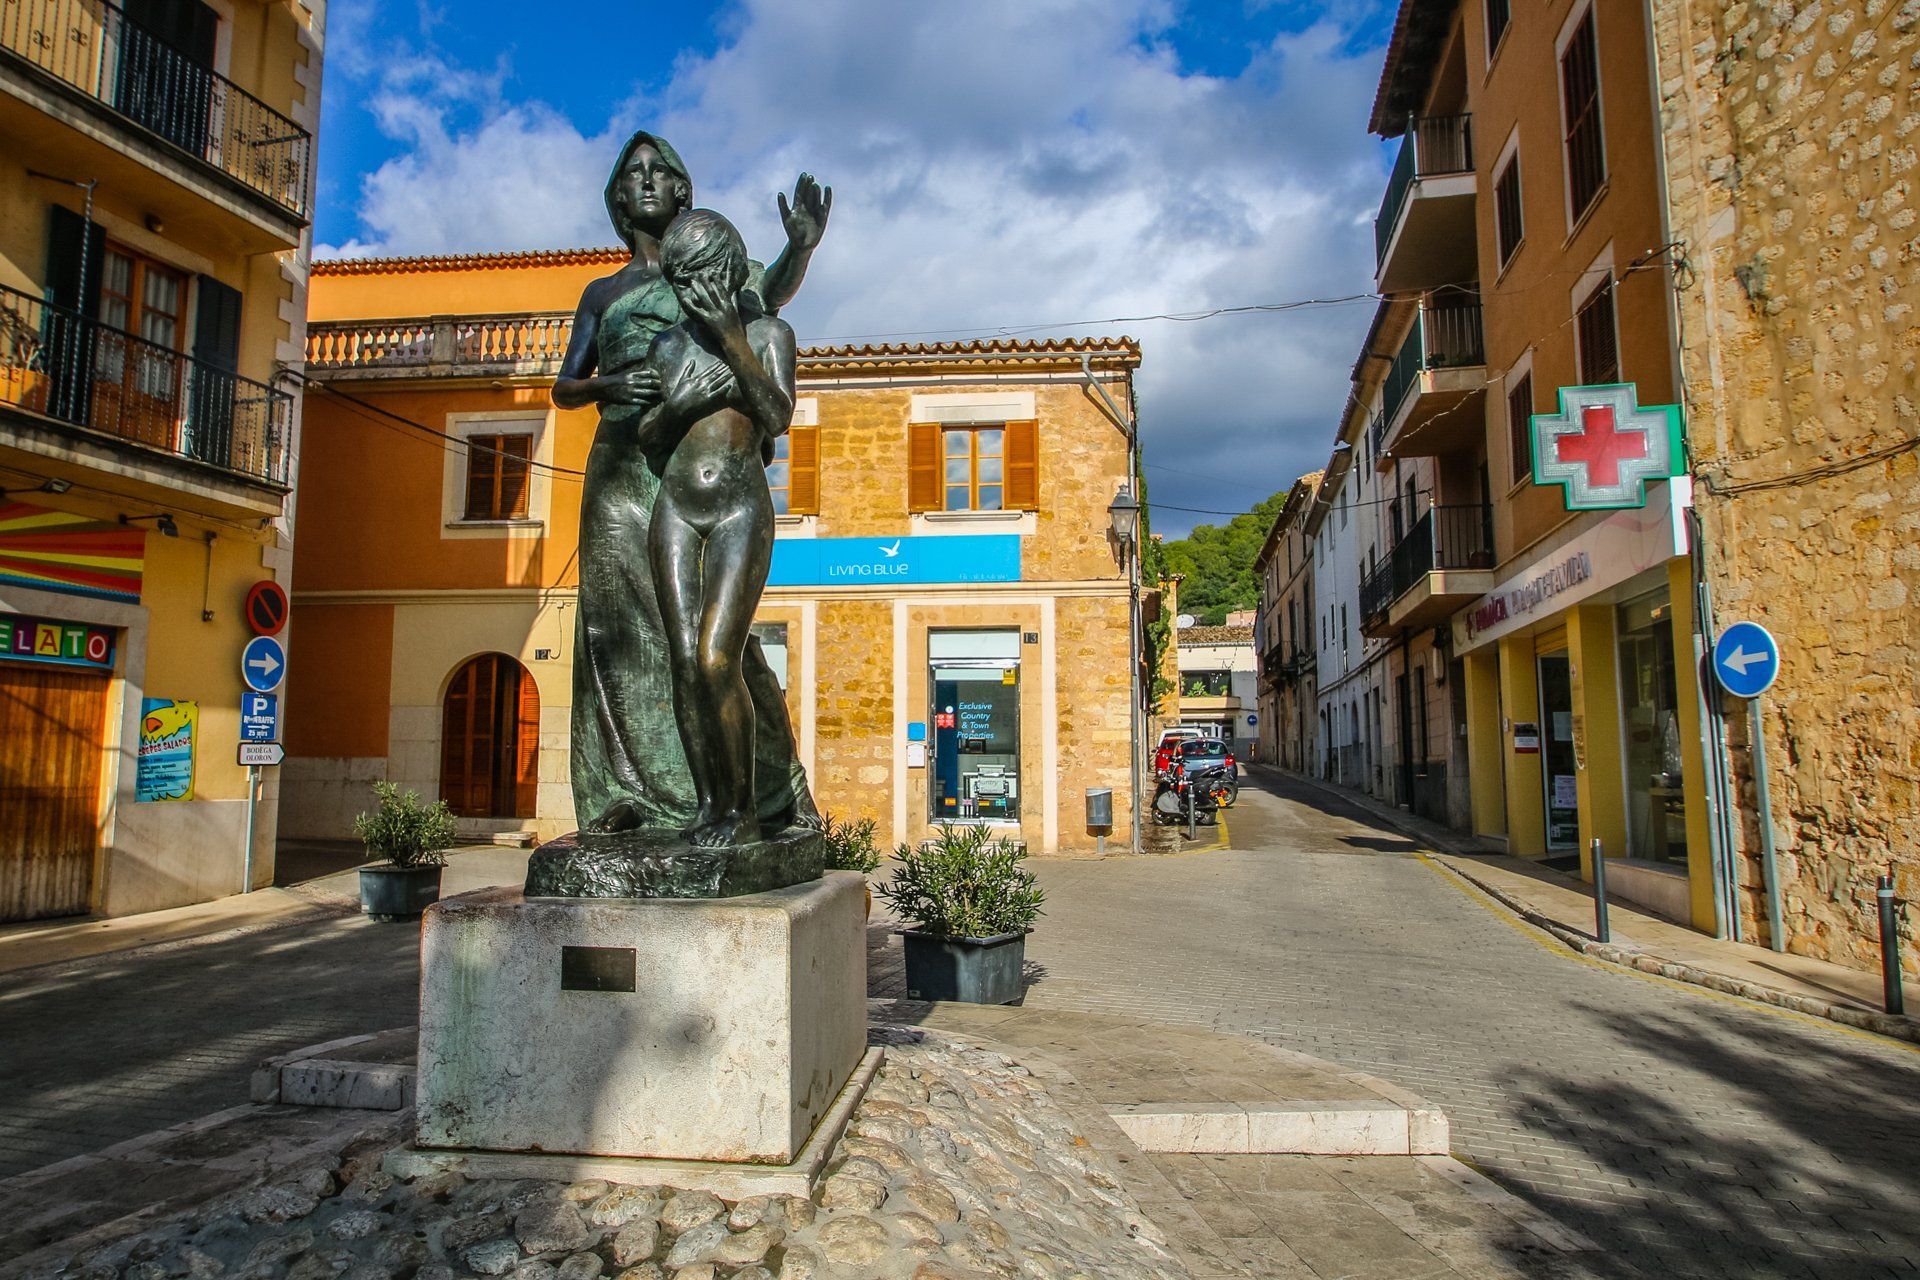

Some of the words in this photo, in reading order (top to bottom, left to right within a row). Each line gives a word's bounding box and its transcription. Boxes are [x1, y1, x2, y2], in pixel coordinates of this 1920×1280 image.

[829, 564, 871, 576] LIVING
[1025, 633, 1037, 643] 13
[536, 650, 547, 659] 12
[253, 697, 268, 716] P
[959, 702, 992, 710] Exclusive
[961, 712, 991, 721] Country
[957, 731, 994, 739] Properties
